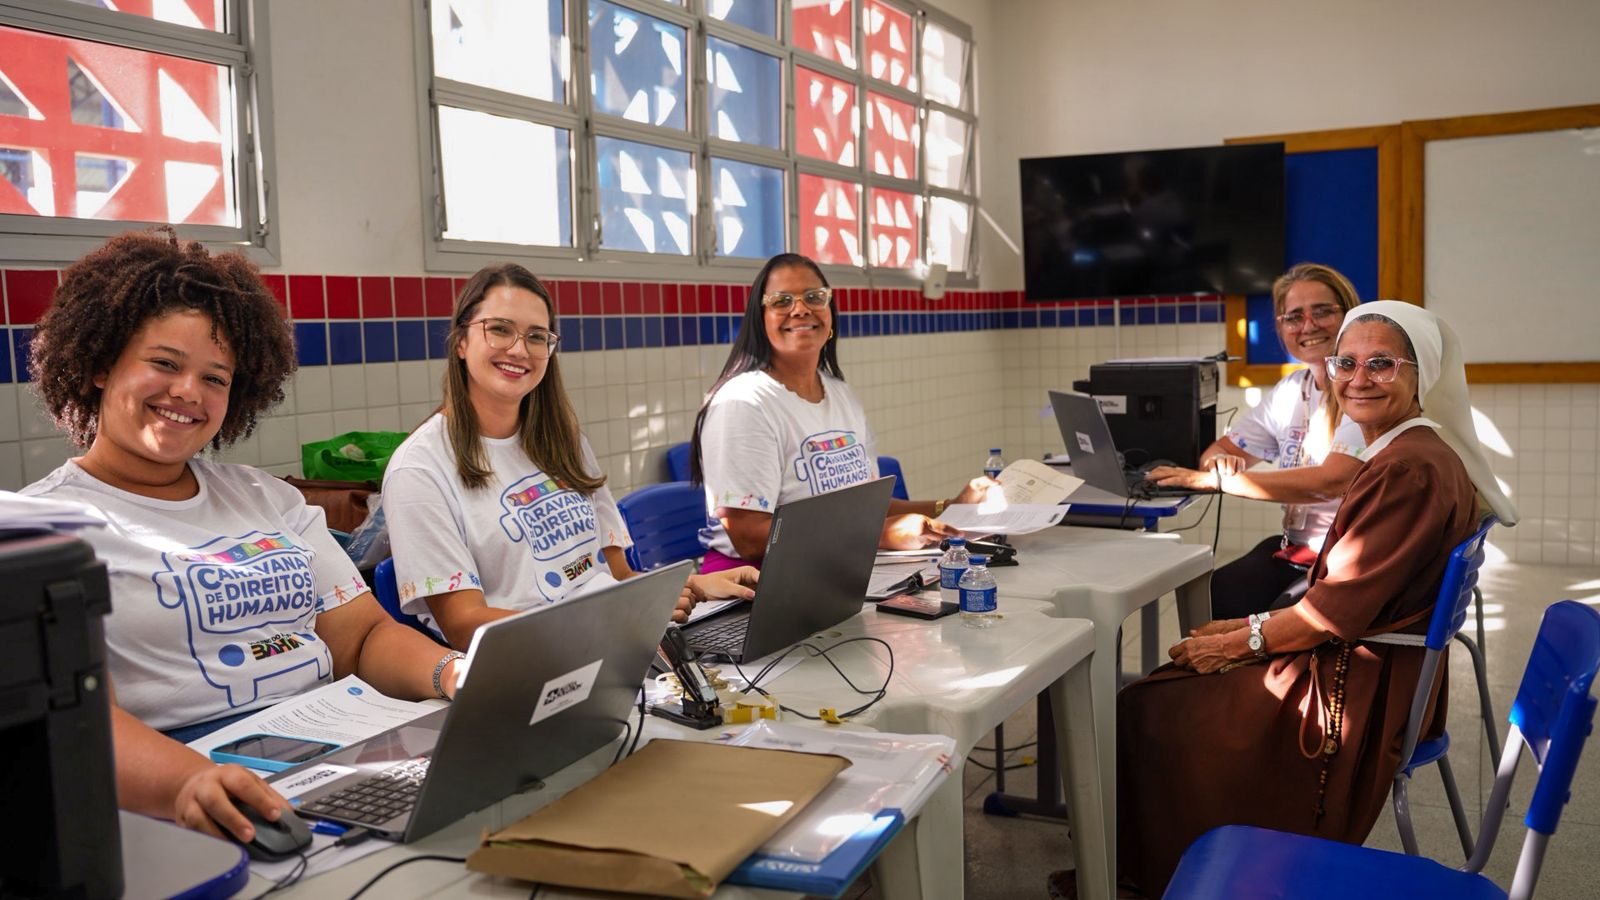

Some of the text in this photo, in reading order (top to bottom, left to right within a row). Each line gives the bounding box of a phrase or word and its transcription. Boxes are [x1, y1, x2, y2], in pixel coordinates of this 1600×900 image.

[821, 469, 867, 491] HUMANOS
[205, 572, 313, 604] DE DIREITOS
[208, 591, 313, 625] HUMANOS
